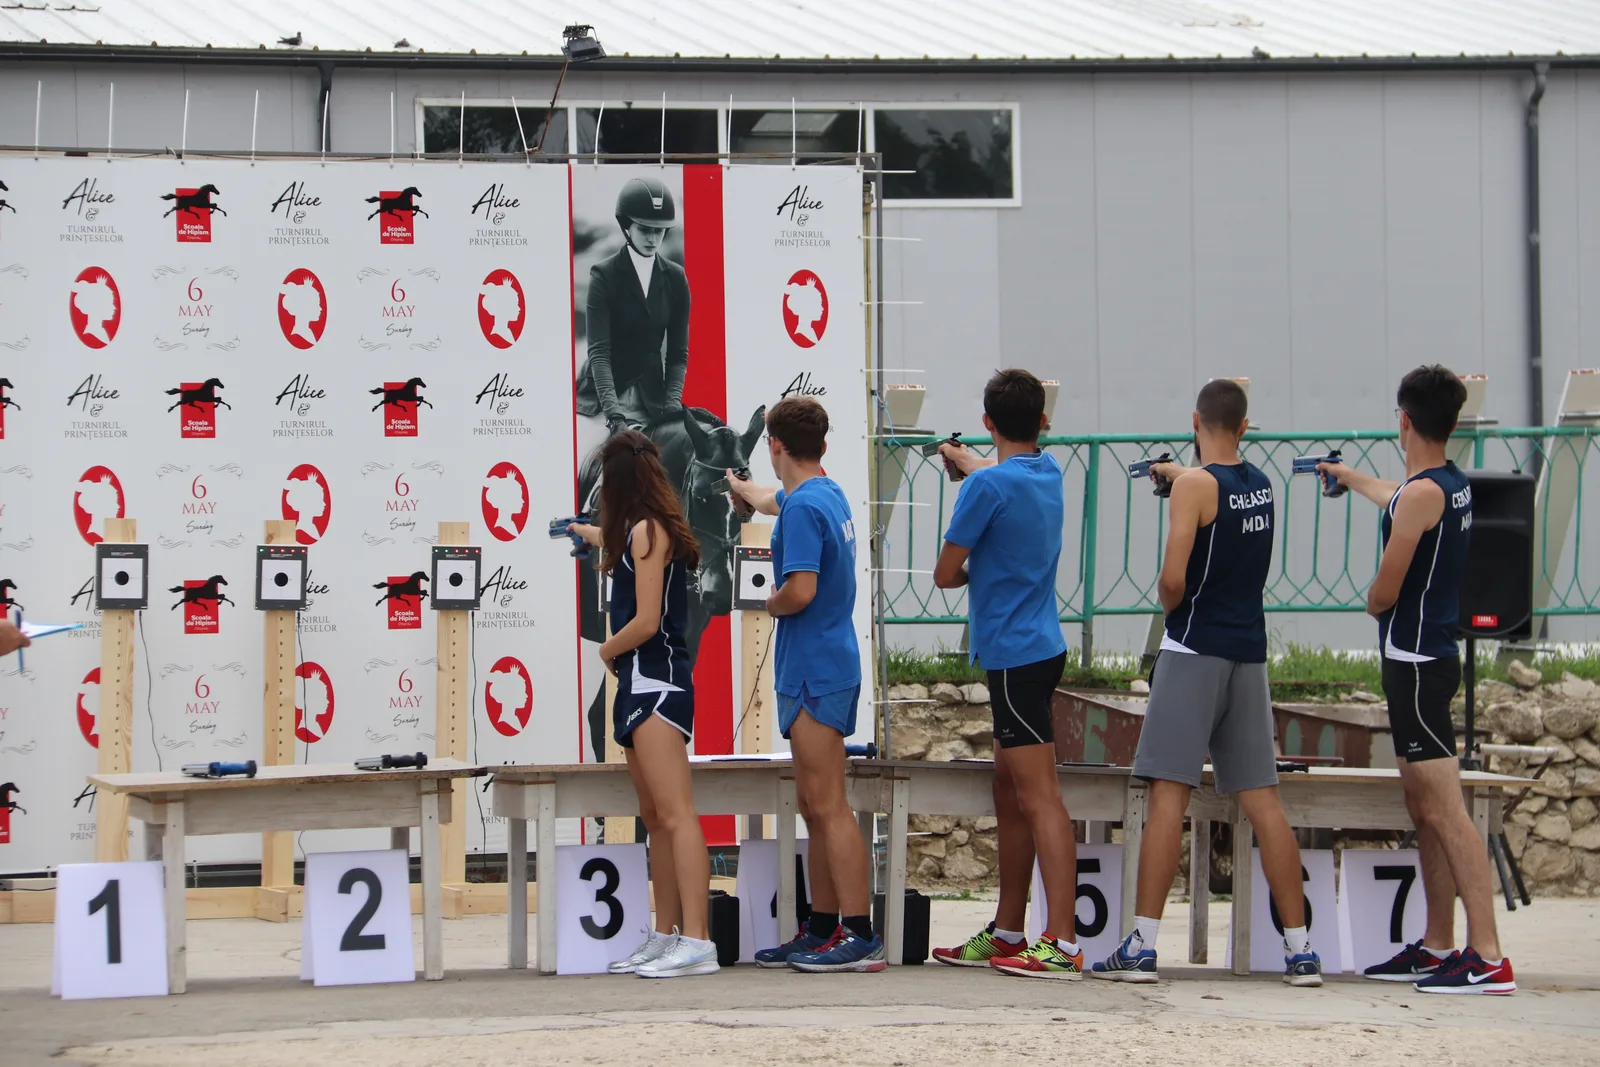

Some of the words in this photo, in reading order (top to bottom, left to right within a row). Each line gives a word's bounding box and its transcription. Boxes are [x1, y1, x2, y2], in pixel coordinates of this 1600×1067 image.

[62, 177, 115, 215] Alice
[271, 181, 322, 219] Alice
[471, 183, 521, 220] Alice
[776, 185, 824, 221] Alice
[67, 225, 116, 234] TURNIRUL
[275, 228, 323, 236] TURNIRUL
[476, 229, 521, 237] TURNIRUL
[780, 230, 824, 238] TURNIRUL
[187, 277, 203, 302] 6
[391, 278, 406, 302] 6
[178, 305, 213, 317] MAY
[382, 305, 416, 318] MAY
[182, 323, 210, 337] Sunday
[386, 323, 413, 337] Sunday
[67, 373, 120, 411] Alice
[275, 373, 326, 410] Alice
[475, 373, 524, 410] Alice
[781, 372, 827, 400] Alice
[71, 421, 121, 429] TURNIRUL
[279, 421, 327, 429] TURNIRUL
[479, 419, 524, 427] TURNIRUL
[191, 474, 207, 499] 6
[395, 472, 410, 496] 6
[182, 502, 218, 514] MAY
[386, 500, 420, 512] MAY
[186, 520, 213, 534] Sunday
[390, 517, 416, 531] Sunday
[1242, 514, 1269, 534] MDA
[306, 570, 330, 594] lice
[480, 565, 528, 602] Alice
[195, 674, 210, 699] 6
[398, 669, 413, 693] 6
[185, 702, 221, 714] MAY
[389, 696, 423, 708] MAY
[189, 720, 216, 734] Sunday
[393, 713, 420, 728] Sunday
[337, 867, 386, 951] 2
[579, 857, 625, 940] 3
[1075, 858, 1108, 938] 5
[1373, 865, 1416, 944] 7
[88, 879, 121, 964] 1
